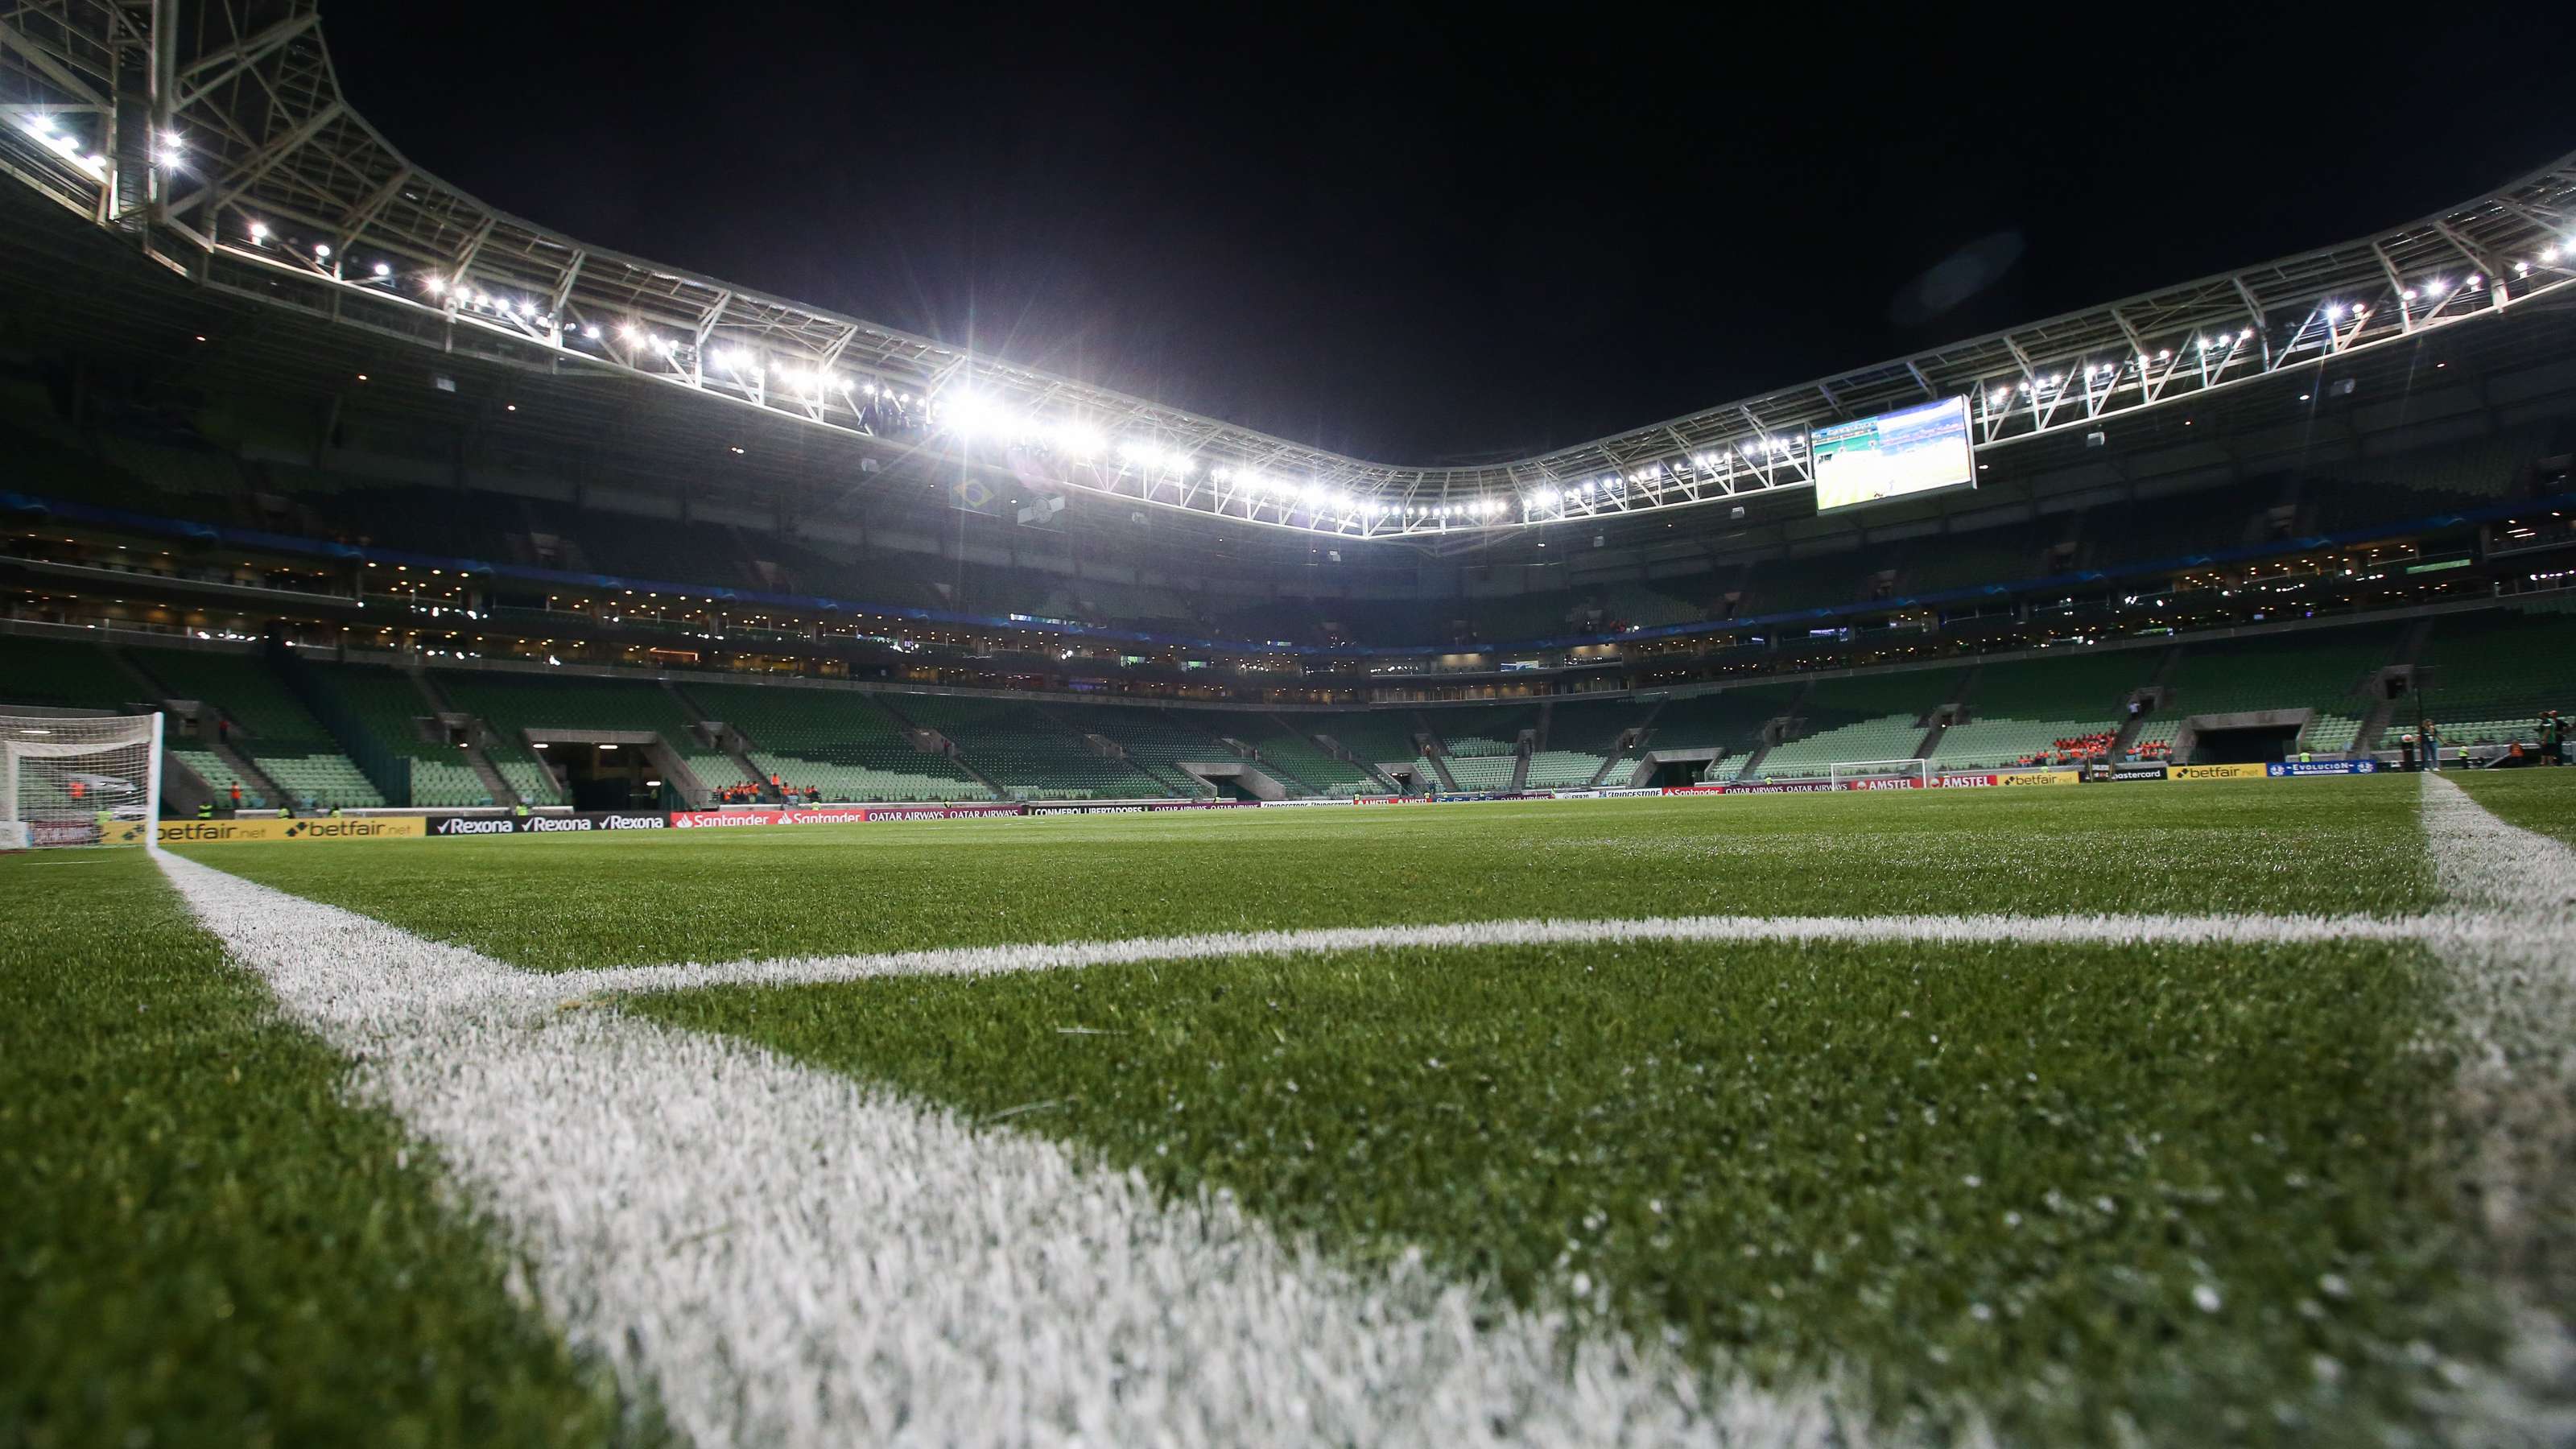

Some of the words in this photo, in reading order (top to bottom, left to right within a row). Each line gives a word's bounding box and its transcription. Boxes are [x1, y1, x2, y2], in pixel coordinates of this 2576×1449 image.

[1869, 779, 1913, 790] AMSTEL
[1942, 776, 1990, 788] AMSTEL
[1752, 786, 1784, 795] AIRWAYS
[1787, 785, 1813, 793] QATAR
[794, 811, 861, 824] Santander
[869, 811, 902, 821] QATAR
[905, 811, 944, 821] AIRWAYS
[950, 810, 980, 819] QATAR
[982, 809, 1018, 819] AIRWAYS
[451, 818, 513, 834] Rexona
[534, 817, 591, 832] Rexona
[610, 815, 663, 830] Rexona
[694, 814, 769, 828] Santander
